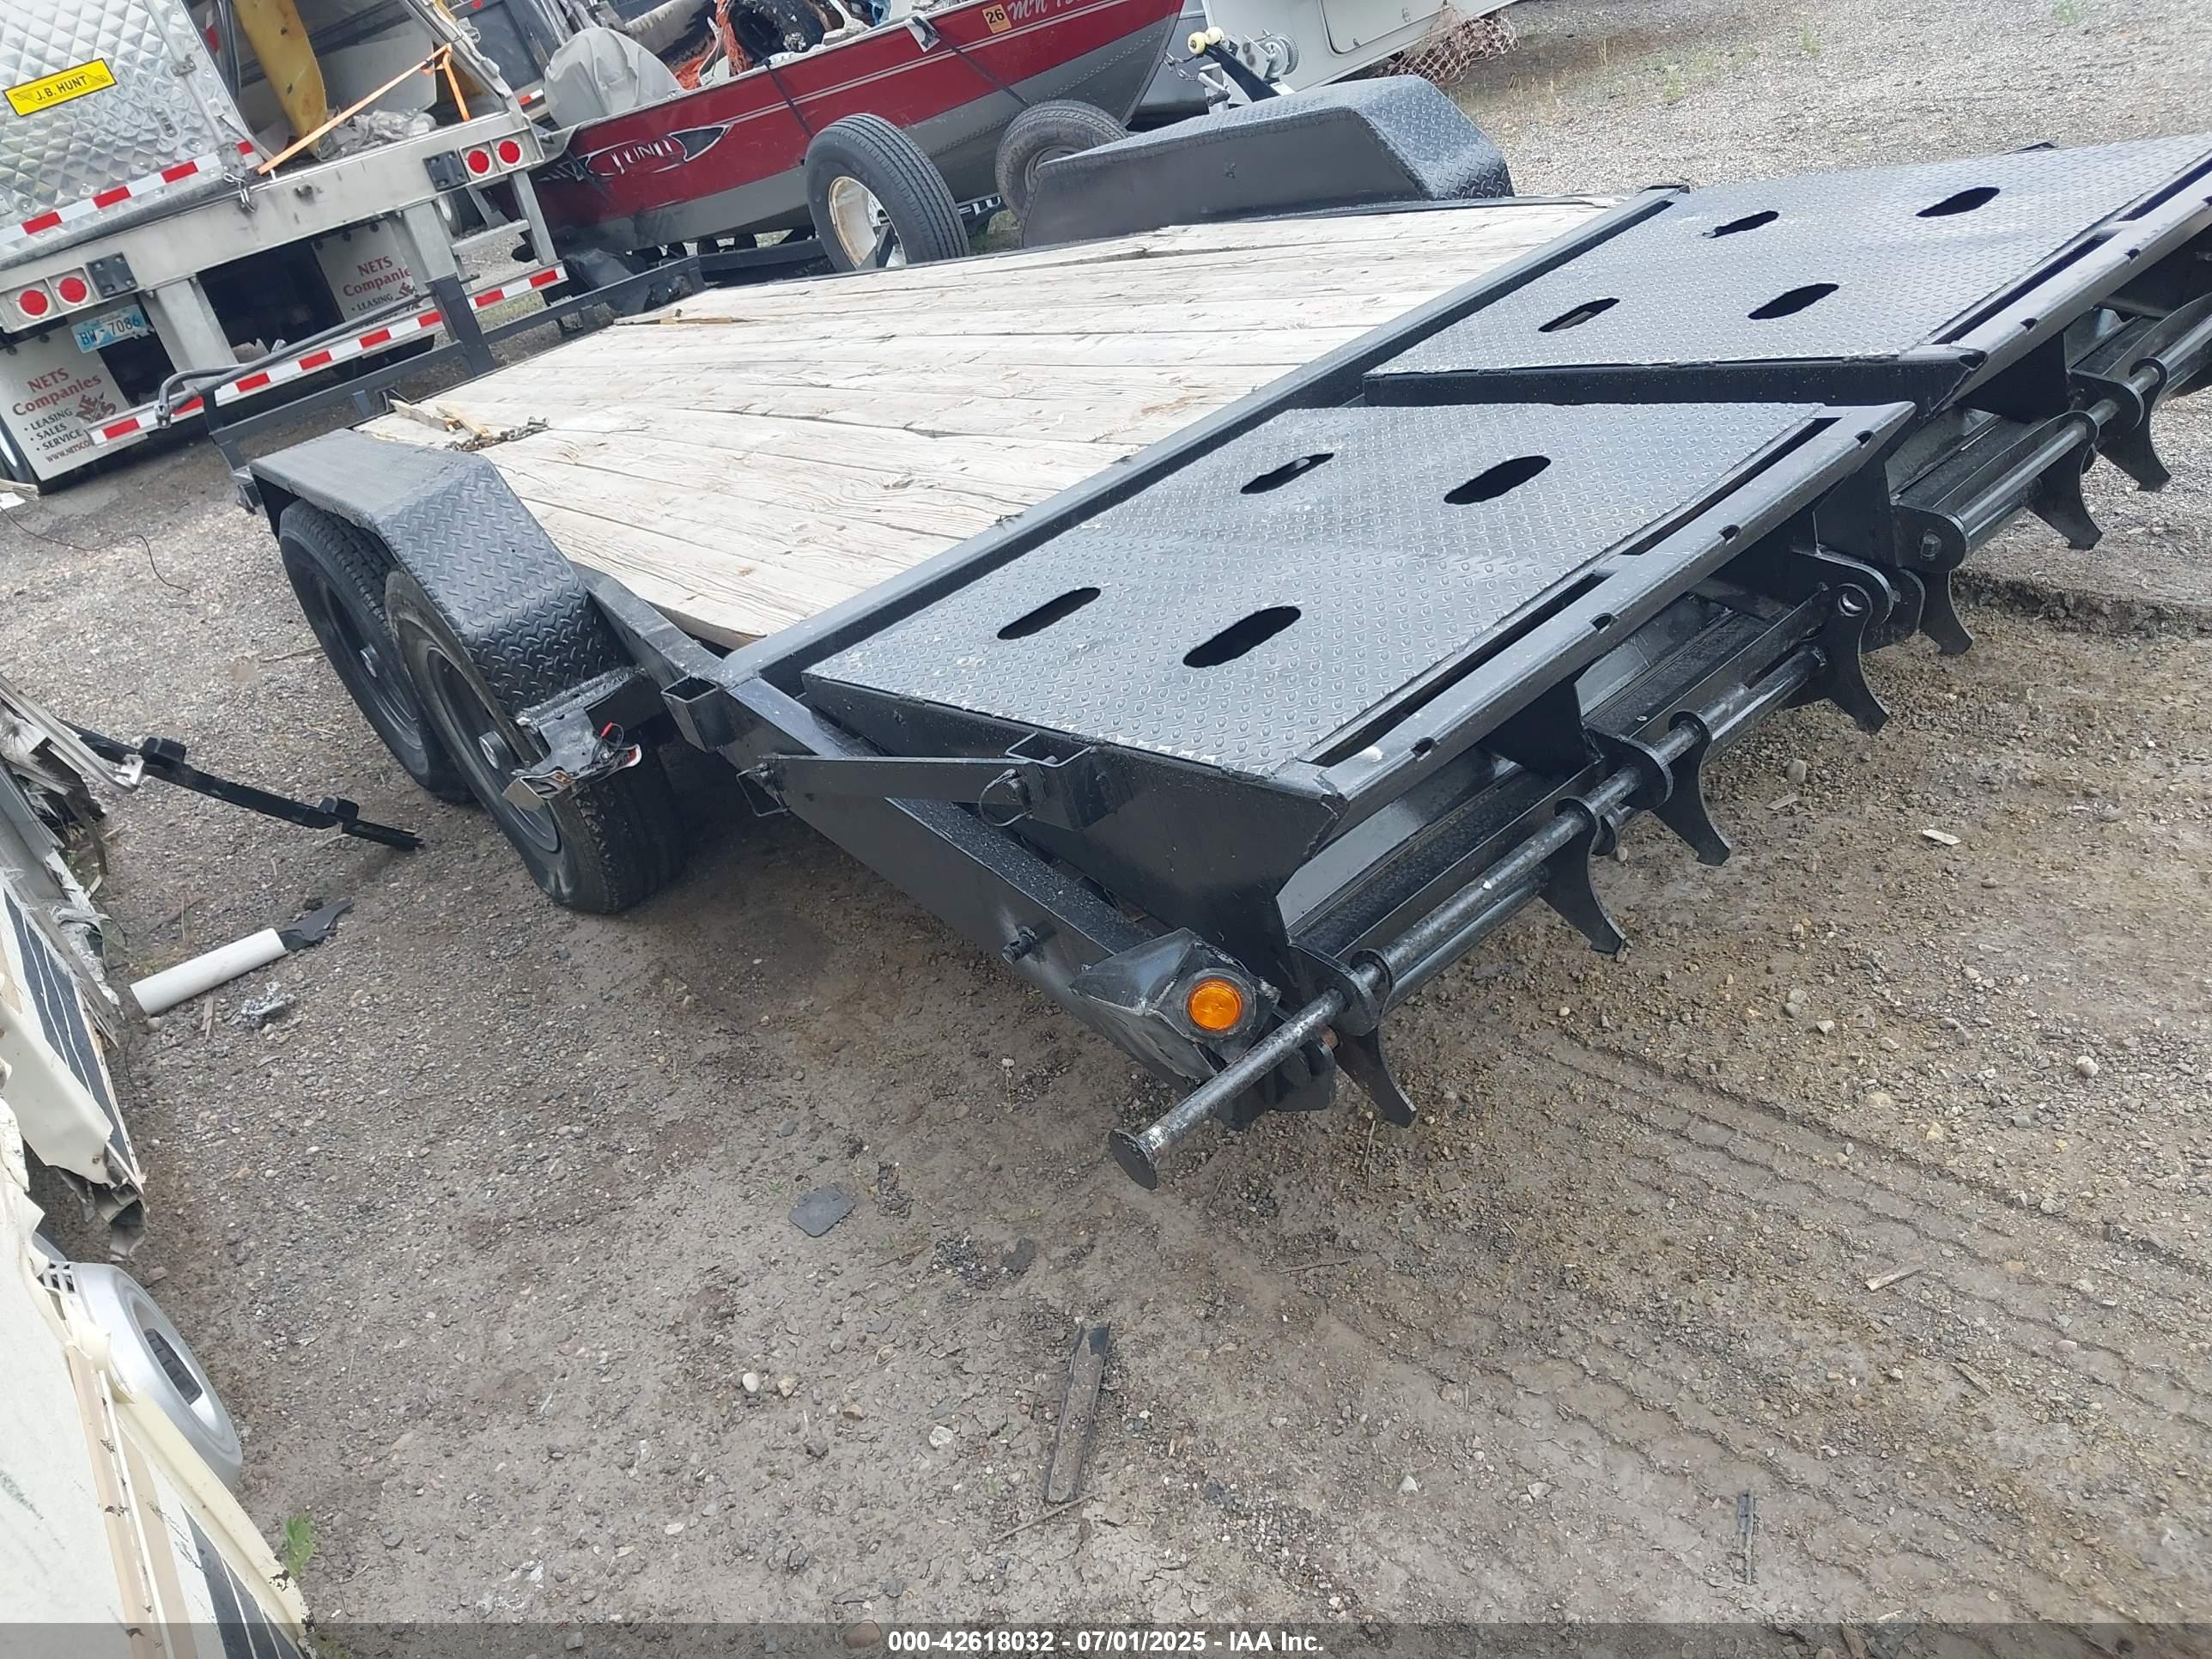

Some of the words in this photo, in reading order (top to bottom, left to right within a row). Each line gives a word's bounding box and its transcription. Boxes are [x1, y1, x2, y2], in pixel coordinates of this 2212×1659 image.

[986, 8, 1005, 24] 26
[35, 87, 57, 101] J.B.
[56, 74, 88, 94] HUNT
[356, 255, 393, 277] NETS
[343, 267, 411, 297] Companie
[356, 293, 394, 312] LEASING
[27, 367, 70, 393] NETS
[12, 374, 102, 416] Companies
[29, 407, 74, 431] LEASING
[35, 422, 68, 441] SALES
